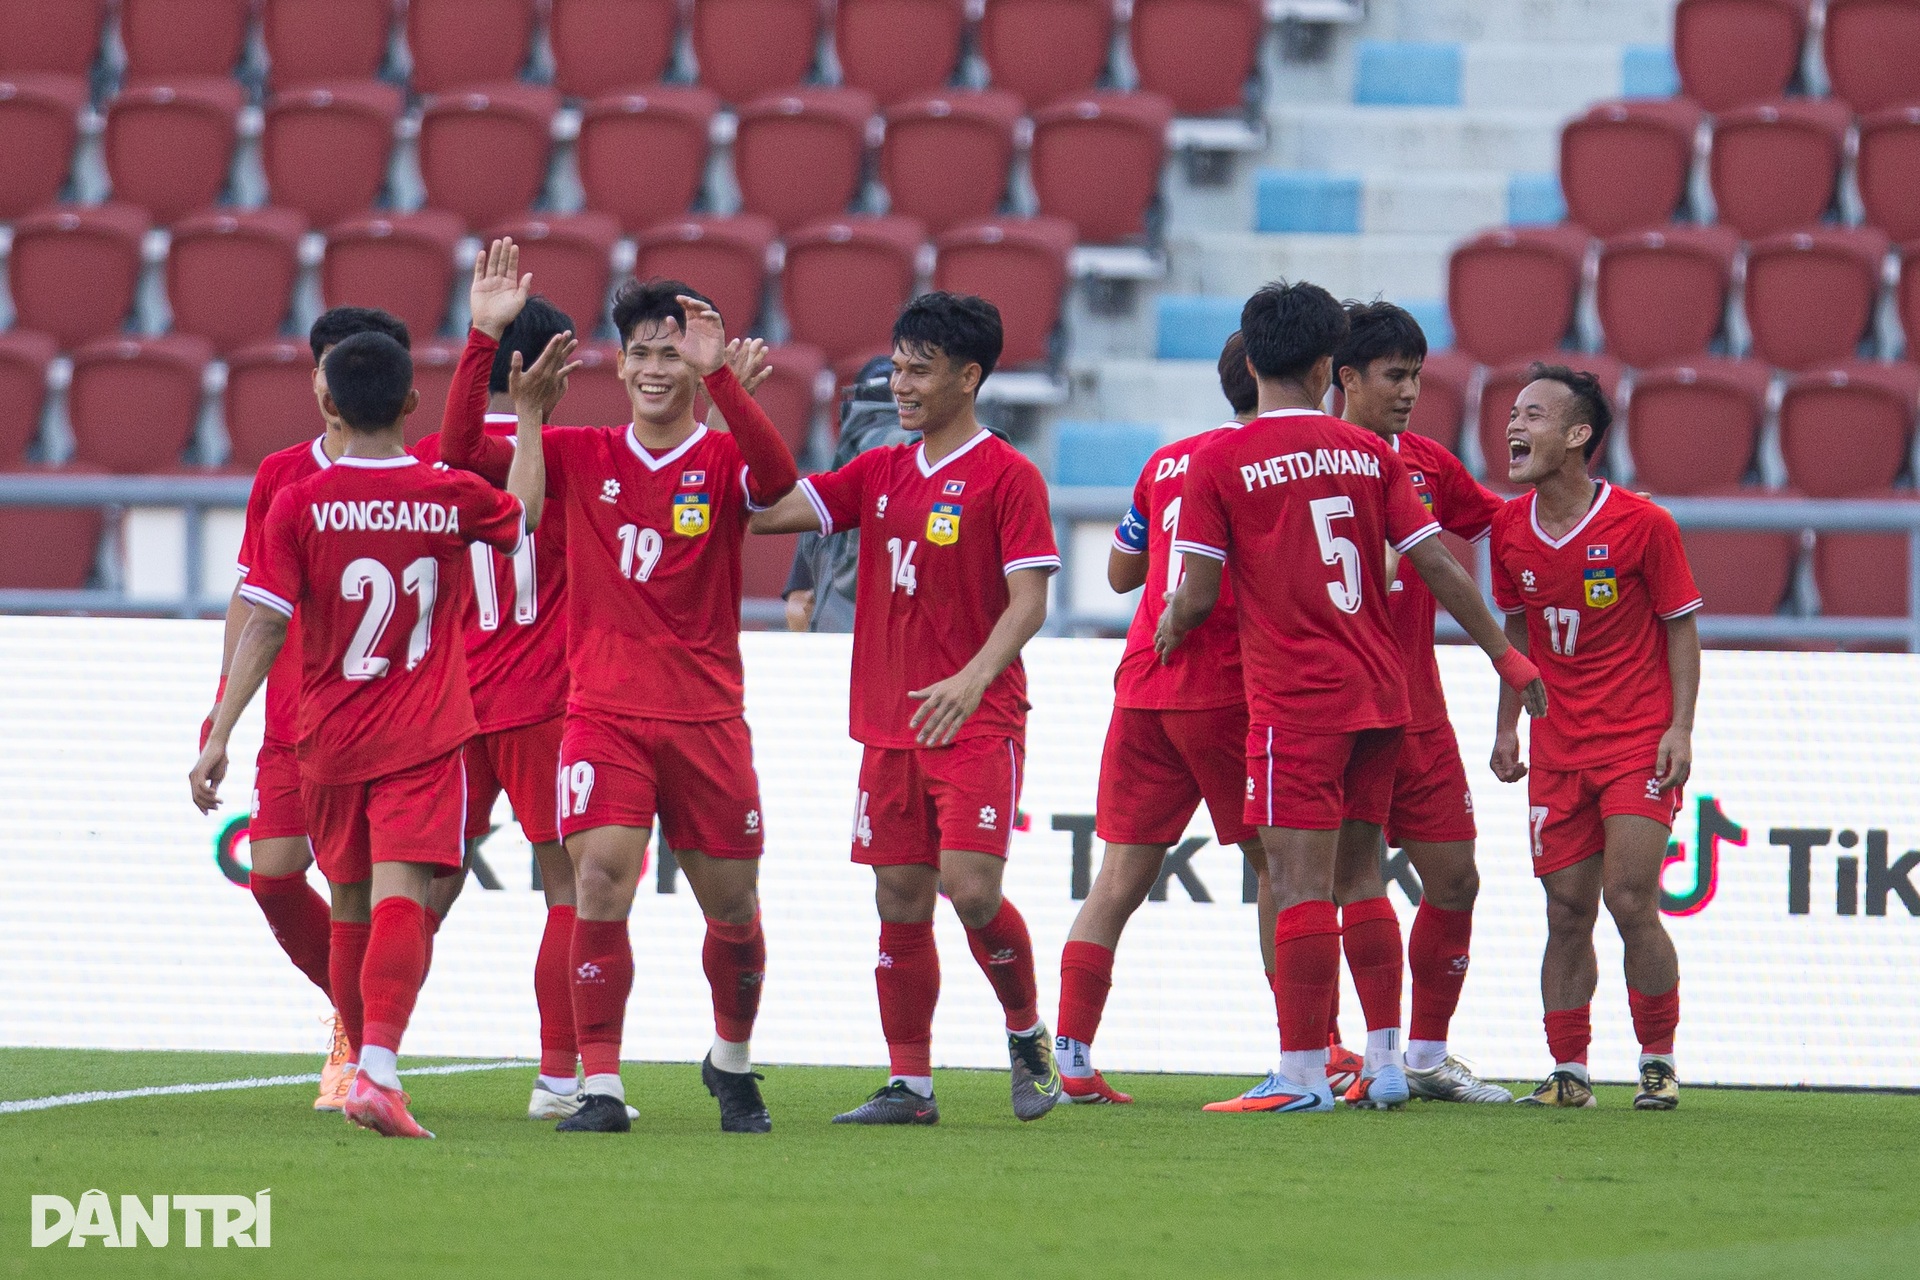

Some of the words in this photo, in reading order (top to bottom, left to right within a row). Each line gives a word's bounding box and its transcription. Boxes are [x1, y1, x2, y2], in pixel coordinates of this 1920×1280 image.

[312, 500, 459, 534] VONGSAKDA
[617, 523, 663, 582] 19
[887, 537, 917, 596] 14
[1309, 495, 1362, 614] 5
[341, 556, 438, 681] 21
[1543, 606, 1580, 657] 17
[560, 760, 595, 818] 19
